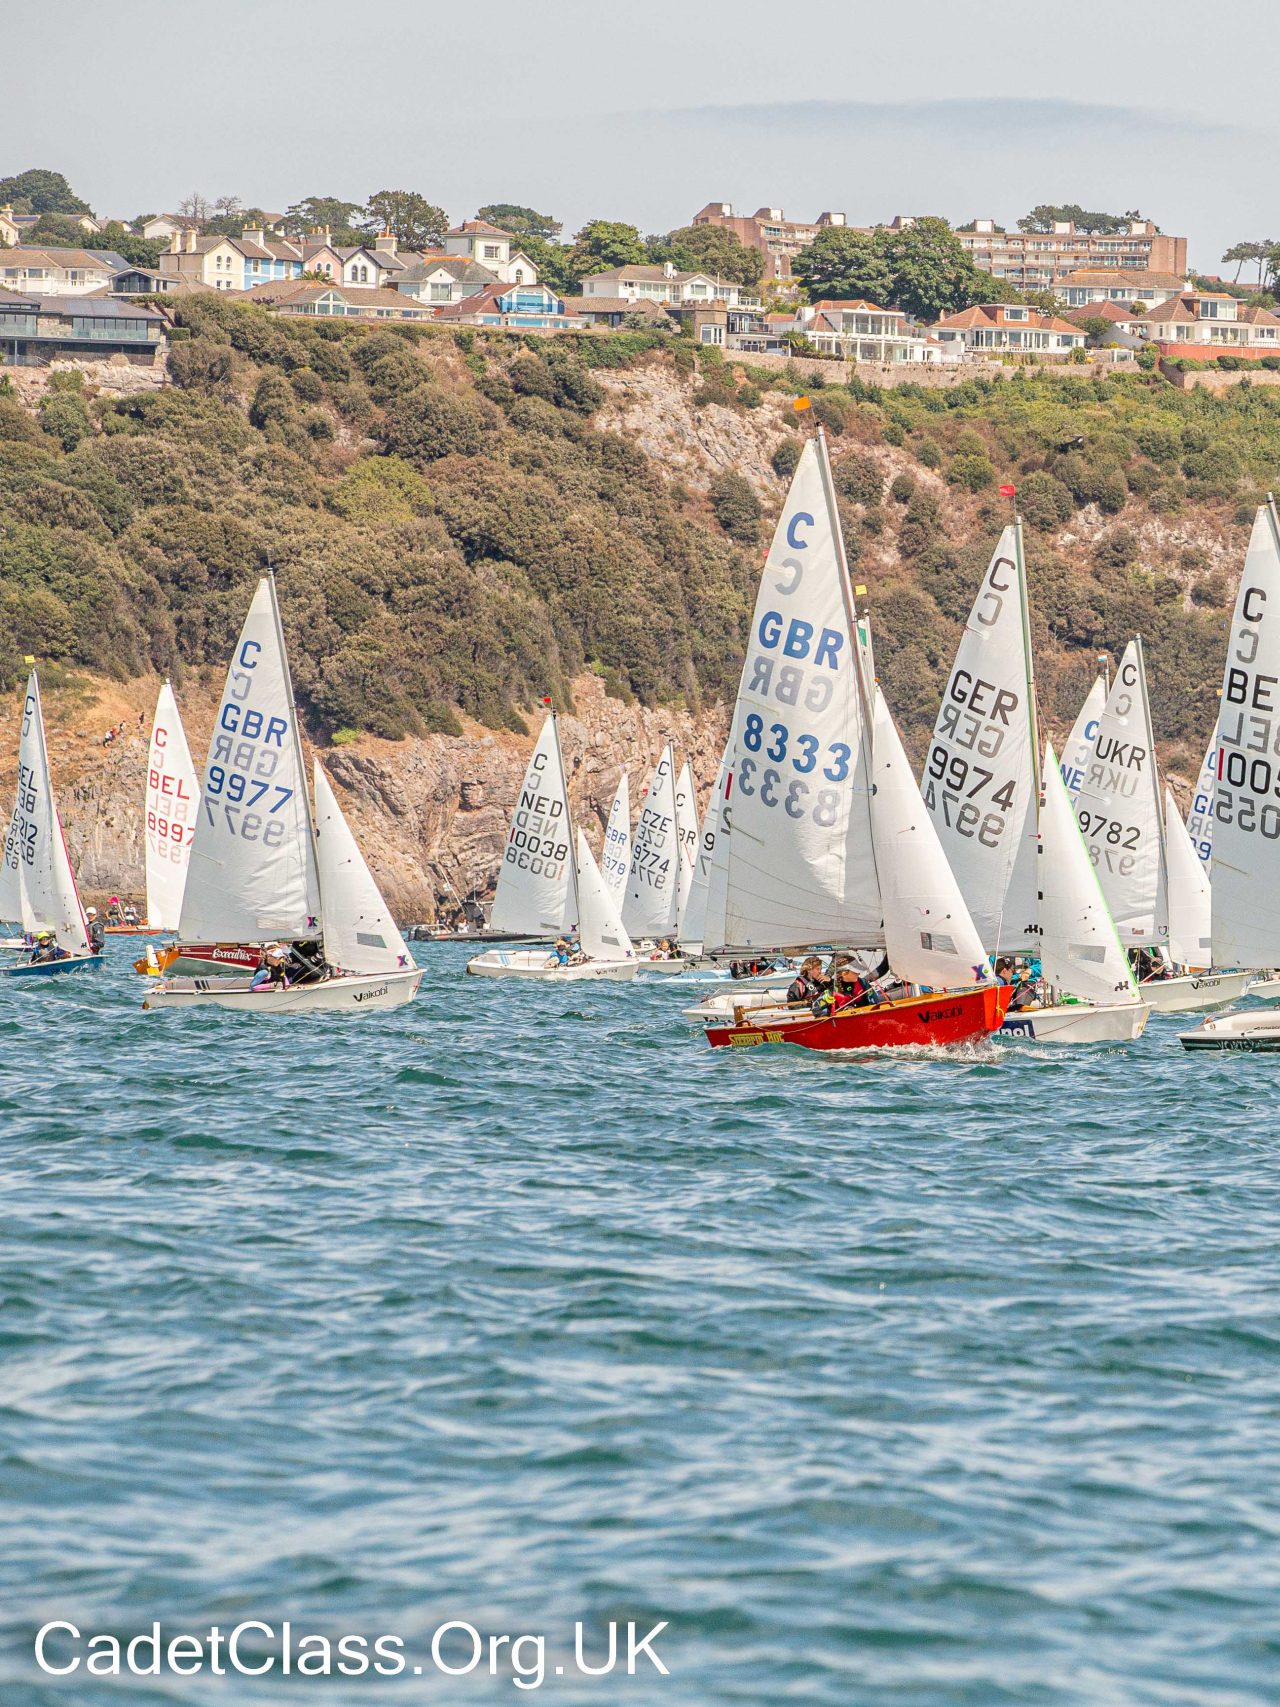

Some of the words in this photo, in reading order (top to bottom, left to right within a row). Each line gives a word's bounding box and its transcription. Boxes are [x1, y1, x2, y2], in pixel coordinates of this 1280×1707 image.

[786, 512, 814, 550] C
[989, 558, 1016, 592] C
[1243, 587, 1266, 622] C
[240, 640, 262, 669] C
[759, 610, 844, 670] GBR
[1122, 664, 1137, 686] C
[25, 696, 35, 715] C
[950, 670, 1018, 726] GER
[155, 728, 167, 748] C
[221, 703, 288, 748] GBR
[1085, 720, 1100, 742] C
[534, 754, 548, 770] C
[744, 713, 851, 782] 8333
[1096, 735, 1146, 772] UKR
[19, 761, 38, 792] EL
[658, 761, 670, 776] C
[929, 746, 1017, 812] 9974
[1060, 764, 1085, 792] NE
[150, 769, 190, 800] BEL
[207, 766, 294, 814] 9977
[676, 793, 686, 806] C
[520, 791, 562, 818] NED
[613, 800, 620, 812] C
[20, 816, 38, 845] 212
[148, 812, 196, 846] 8997
[642, 808, 672, 833] CZE
[1079, 810, 1141, 850] 9782
[510, 828, 568, 861] 10038
[634, 844, 670, 874] 9774
[353, 986, 388, 1002] Vaikobi
[918, 1004, 963, 1023] Vaikobi
